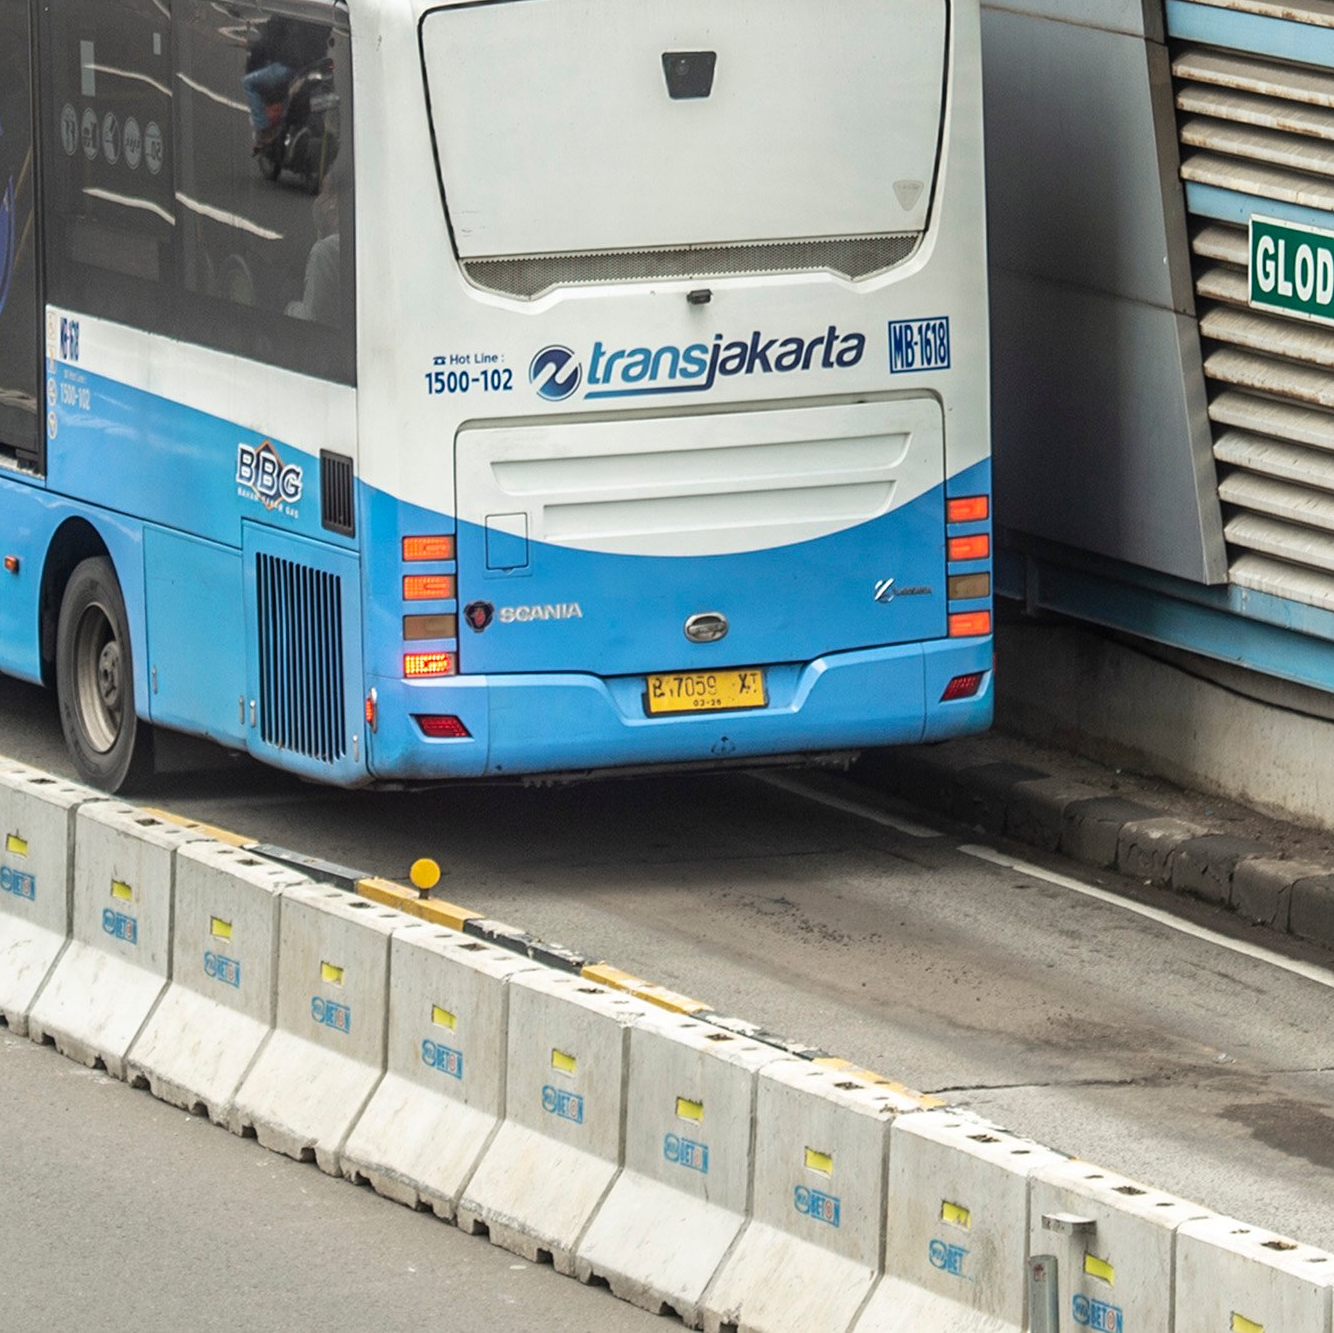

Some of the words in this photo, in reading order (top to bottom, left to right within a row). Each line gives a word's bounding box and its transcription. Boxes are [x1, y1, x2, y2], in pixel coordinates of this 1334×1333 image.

[450, 353, 471, 365] Hot
[474, 352, 499, 364] Line
[892, 320, 947, 370] MB-1618
[586, 325, 866, 395] transjakarta
[425, 368, 513, 395] 1500-102
[236, 442, 303, 503] BBG
[499, 602, 583, 623] SCANIA
[653, 677, 665, 698] B
